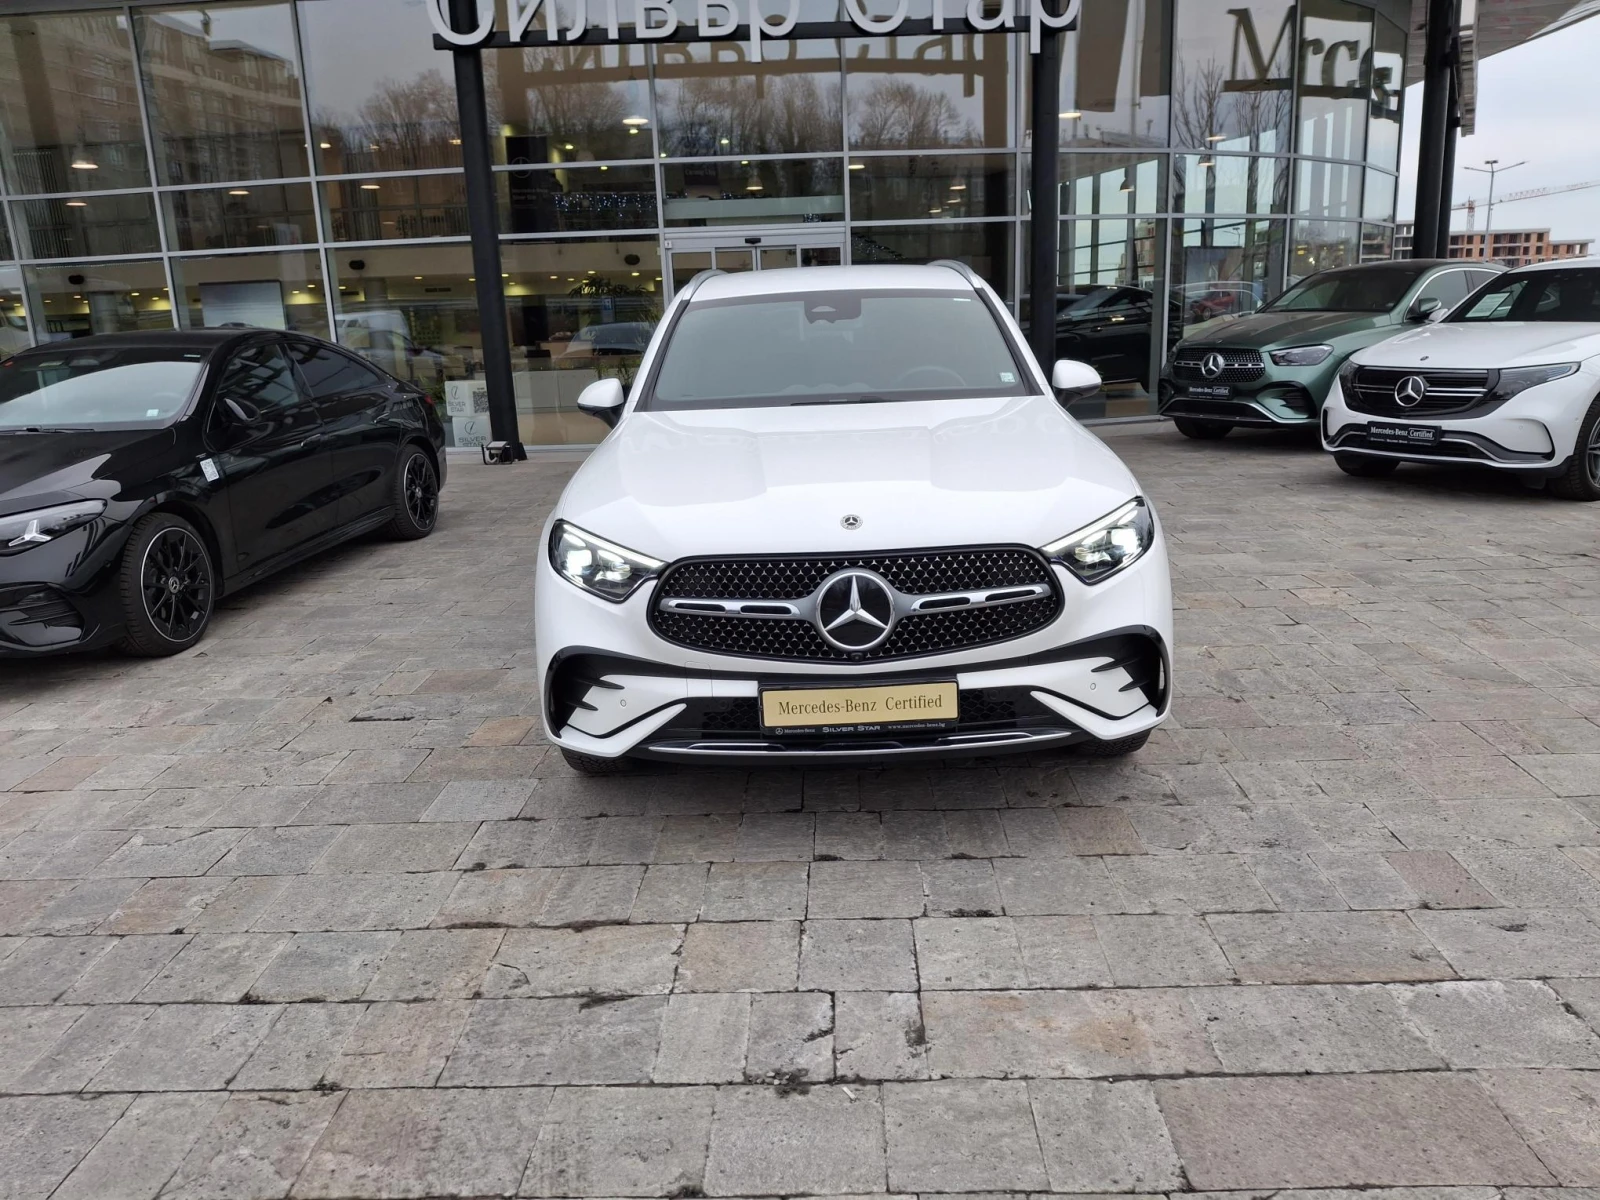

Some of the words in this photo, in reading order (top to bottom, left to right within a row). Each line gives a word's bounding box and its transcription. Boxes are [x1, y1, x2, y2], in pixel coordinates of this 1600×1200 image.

[1370, 426, 1408, 436] Mercedes-Benz
[1409, 430, 1433, 438] Certified
[778, 699, 877, 715] Mercedes-Benz
[885, 694, 943, 711] Certified
